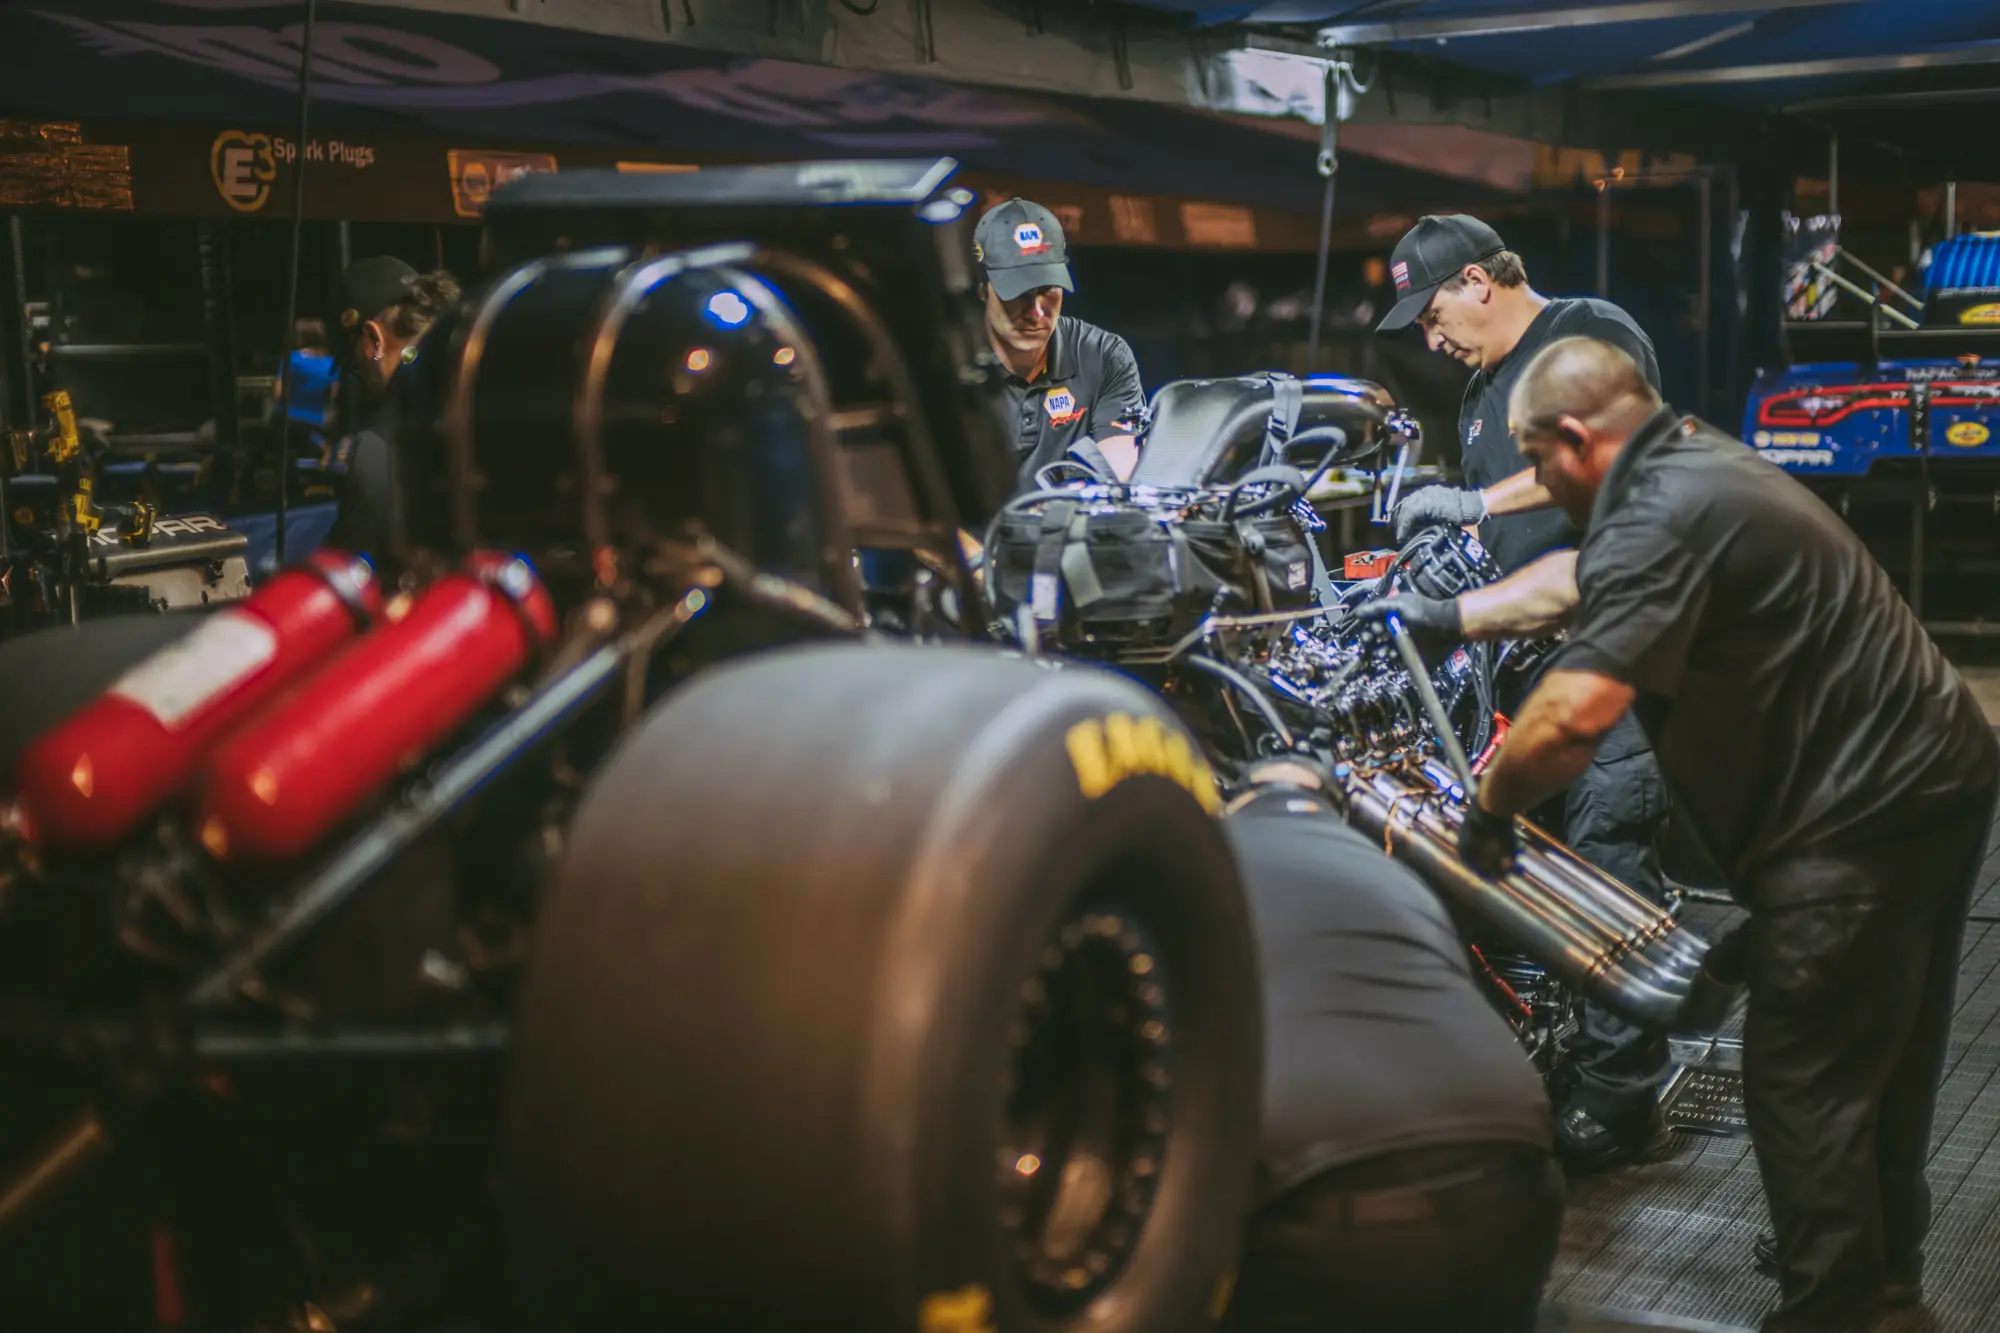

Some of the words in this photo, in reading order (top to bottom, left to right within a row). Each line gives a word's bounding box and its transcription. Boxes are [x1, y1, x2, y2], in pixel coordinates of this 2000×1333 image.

[273, 138, 324, 163] Sprk
[328, 140, 374, 168] Plugs
[1049, 396, 1070, 410] NAPA
